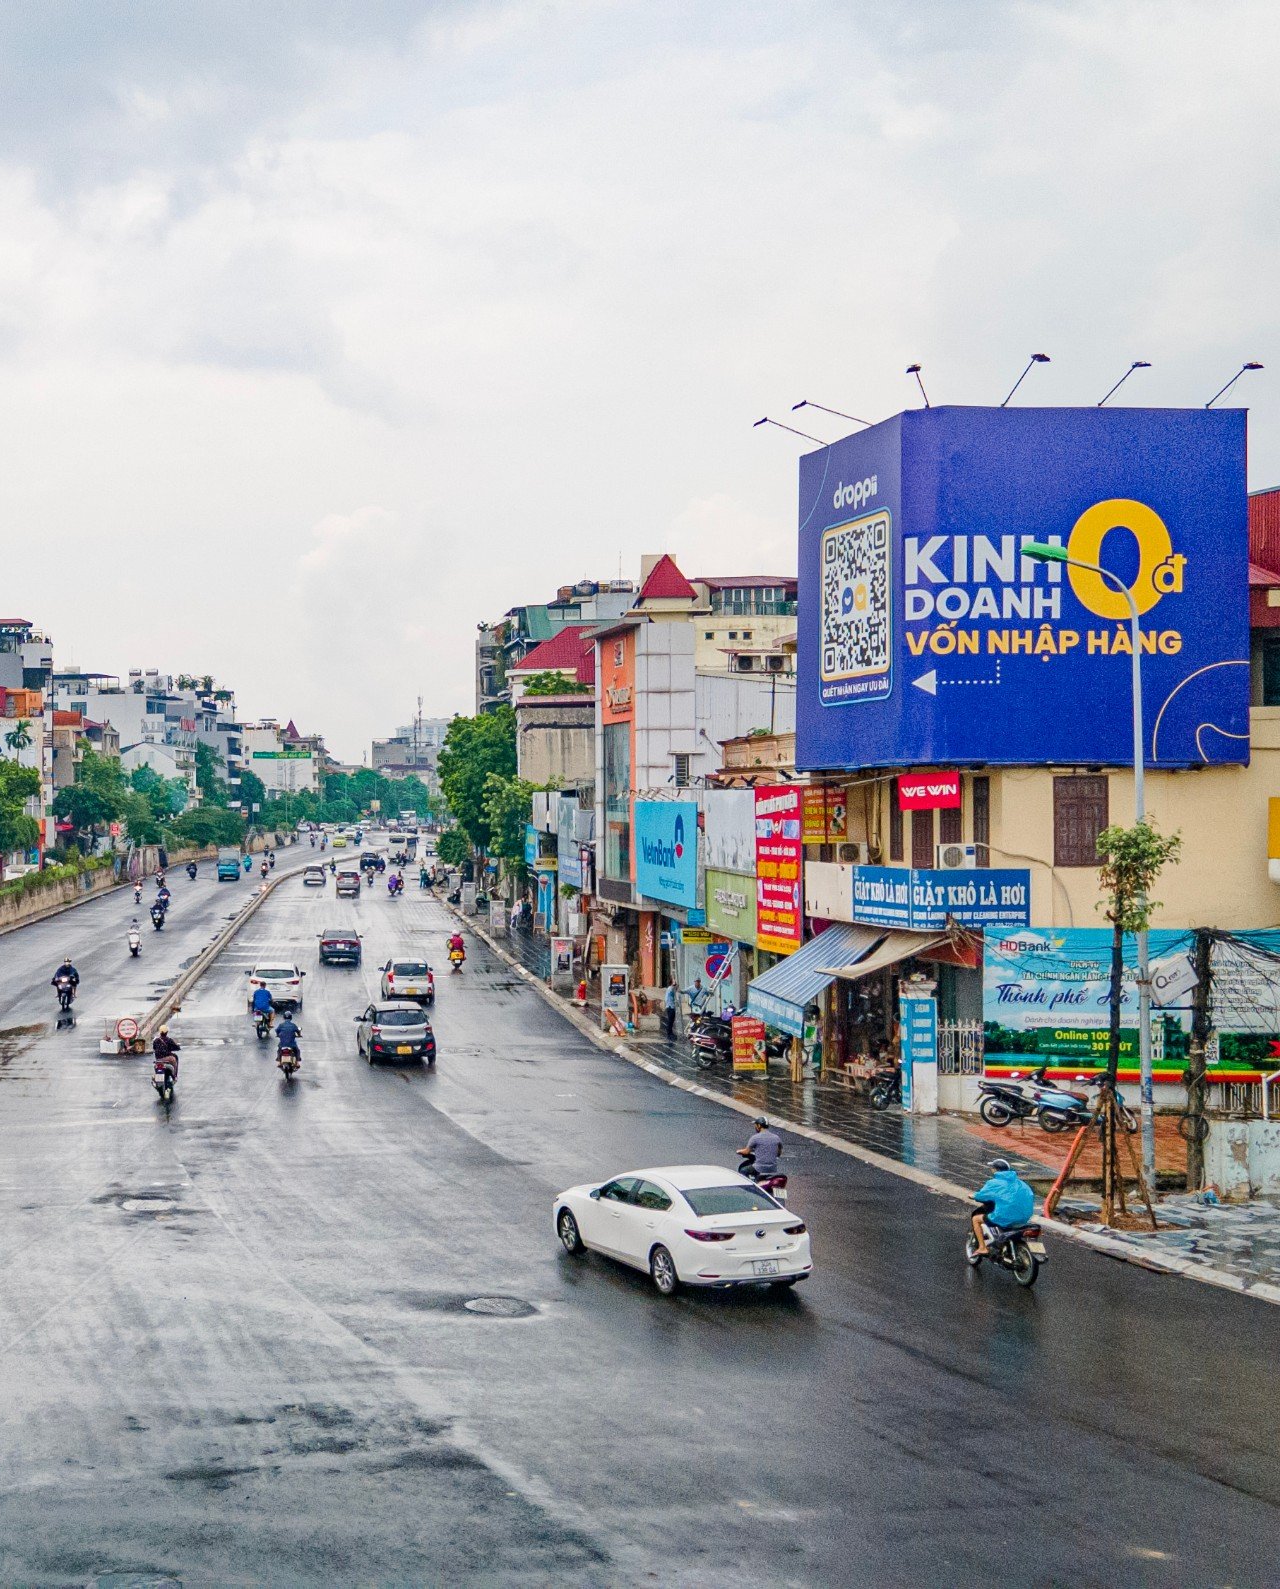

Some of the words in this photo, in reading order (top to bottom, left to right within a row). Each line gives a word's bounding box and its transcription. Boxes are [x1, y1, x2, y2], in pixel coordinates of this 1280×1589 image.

[905, 535, 1062, 585] KINH
[905, 587, 1061, 621] DOANH
[906, 621, 979, 656] VỐN
[987, 624, 1079, 662] NHẬP
[1088, 624, 1182, 655] HÀNG
[853, 681, 869, 693] NGAY
[901, 785, 926, 798] WE
[927, 783, 956, 797] WIN
[641, 836, 676, 869] VietinBank
[855, 876, 870, 905] GIẶT
[870, 877, 885, 902] KHÔ
[885, 878, 895, 904] LÀ
[895, 881, 908, 905] HƠI
[913, 879, 945, 911] GIẶT
[947, 879, 977, 906] KHÔ
[980, 880, 998, 906] LÀ
[1001, 882, 1026, 906] HƠI
[999, 940, 1051, 952] HDBank
[995, 983, 1047, 1004] Thành
[1048, 987, 1090, 1010] phố
[1058, 1016, 1080, 1024] doanh
[1054, 1030, 1089, 1040] Online
[1091, 1031, 1111, 1040] 100
[1091, 1042, 1104, 1050] 30
[1105, 1041, 1132, 1050] PÚT
